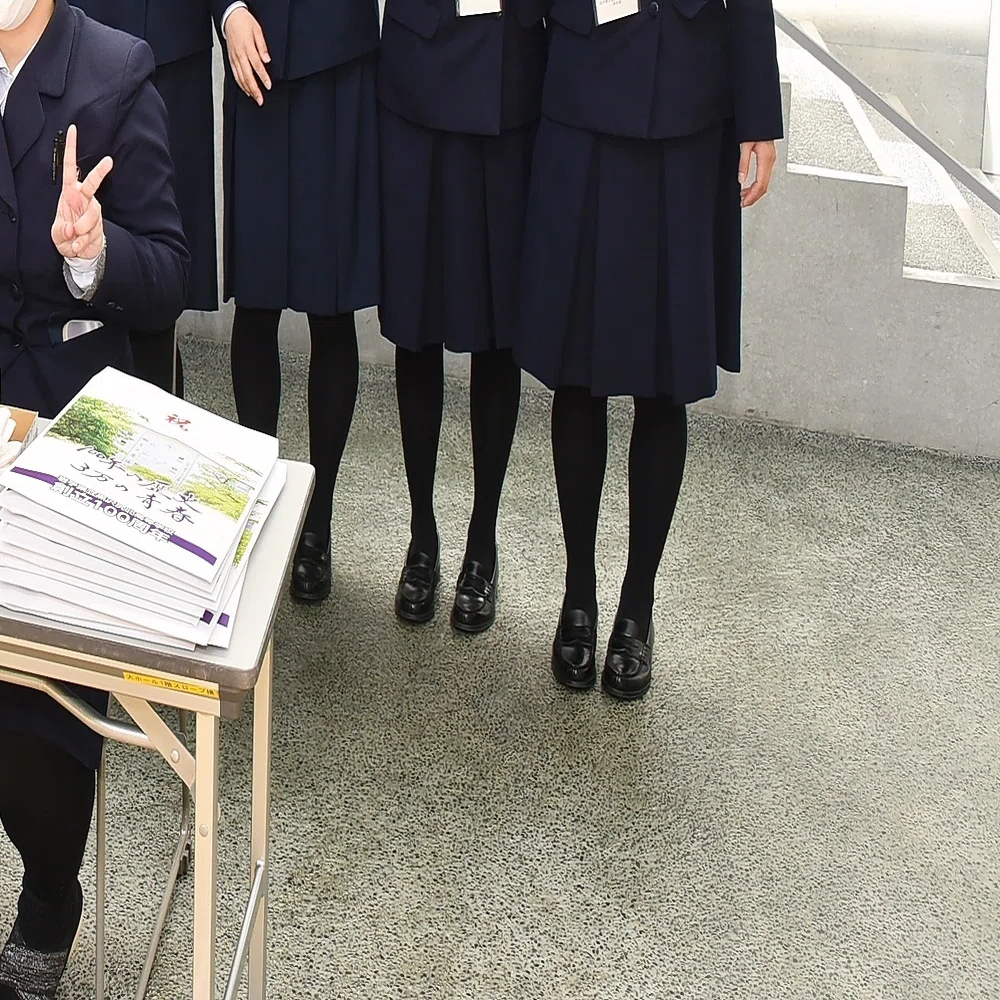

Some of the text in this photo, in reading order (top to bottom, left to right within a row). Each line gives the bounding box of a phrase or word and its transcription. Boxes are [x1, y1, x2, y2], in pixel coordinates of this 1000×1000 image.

[164, 413, 193, 432] 祝
[49, 481, 173, 543] 創立100周年
